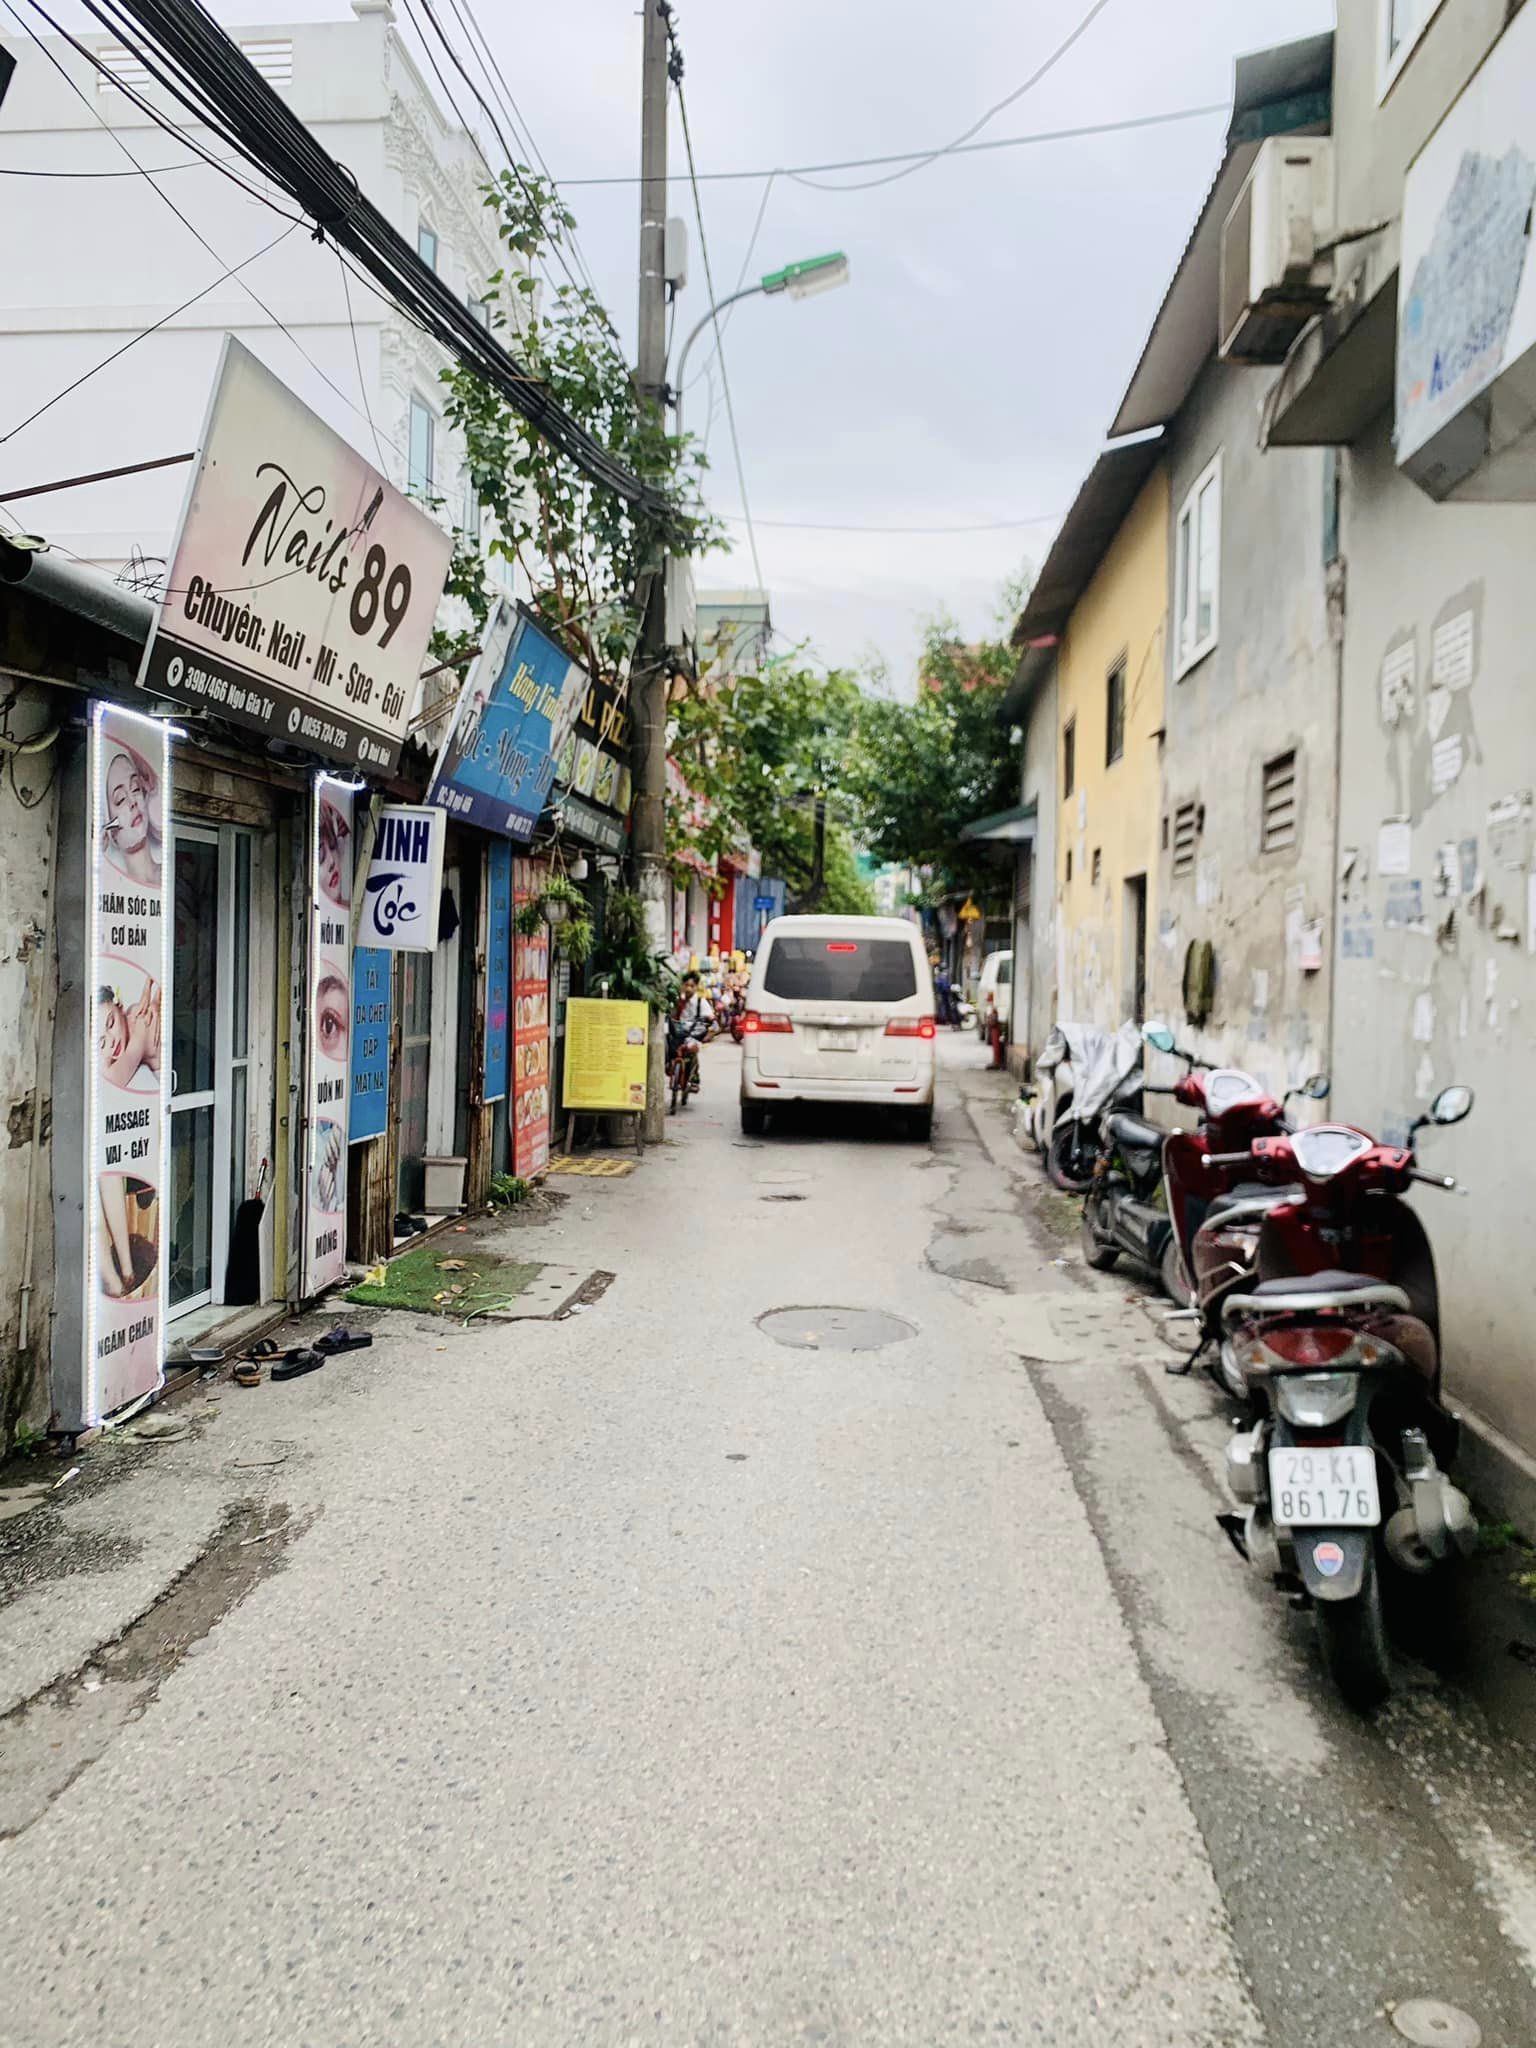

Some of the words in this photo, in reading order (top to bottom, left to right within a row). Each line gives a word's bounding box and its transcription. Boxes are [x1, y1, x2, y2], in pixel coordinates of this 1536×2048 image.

[242, 463, 348, 593] Nails
[350, 544, 411, 649] 89
[184, 576, 265, 652] Chuyên:
[266, 620, 306, 670] Nail
[313, 644, 338, 687] Mi
[345, 662, 373, 705] Spa
[127, 894, 147, 916] SÓC
[111, 924, 126, 946] CƠ
[127, 923, 147, 946] BẢN
[335, 924, 345, 945] MI
[334, 1079, 344, 1100] MI
[105, 1108, 150, 1134] MASSAGE
[105, 1143, 121, 1165] VAI
[1281, 1490, 1370, 1519] 861.76
